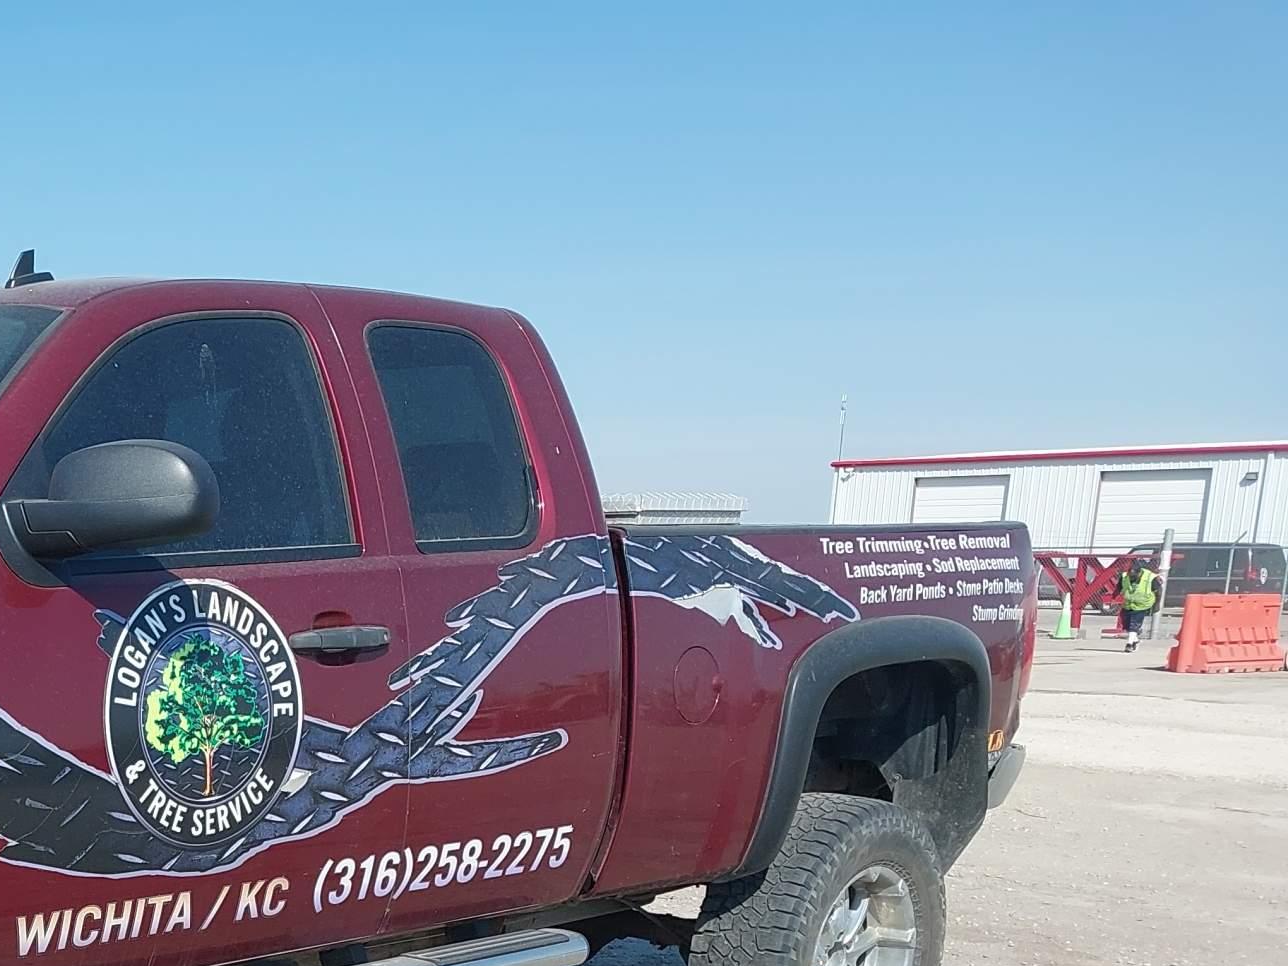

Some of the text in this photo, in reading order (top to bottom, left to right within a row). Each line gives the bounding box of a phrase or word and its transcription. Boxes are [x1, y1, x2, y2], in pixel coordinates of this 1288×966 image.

[819, 537, 854, 554] Tree
[958, 533, 1011, 549] Removal
[844, 556, 1020, 579] Landscaping Sod Replacement
[860, 578, 1024, 604] Back Yard Ponds Stone Patio Decks
[972, 604, 997, 624] Stump
[114, 589, 294, 718] LOGAN'S LANDSCAPE
[125, 759, 274, 837] & TREE SERVICE
[15, 824, 574, 958] WICHITA / KC (316)258-2275
